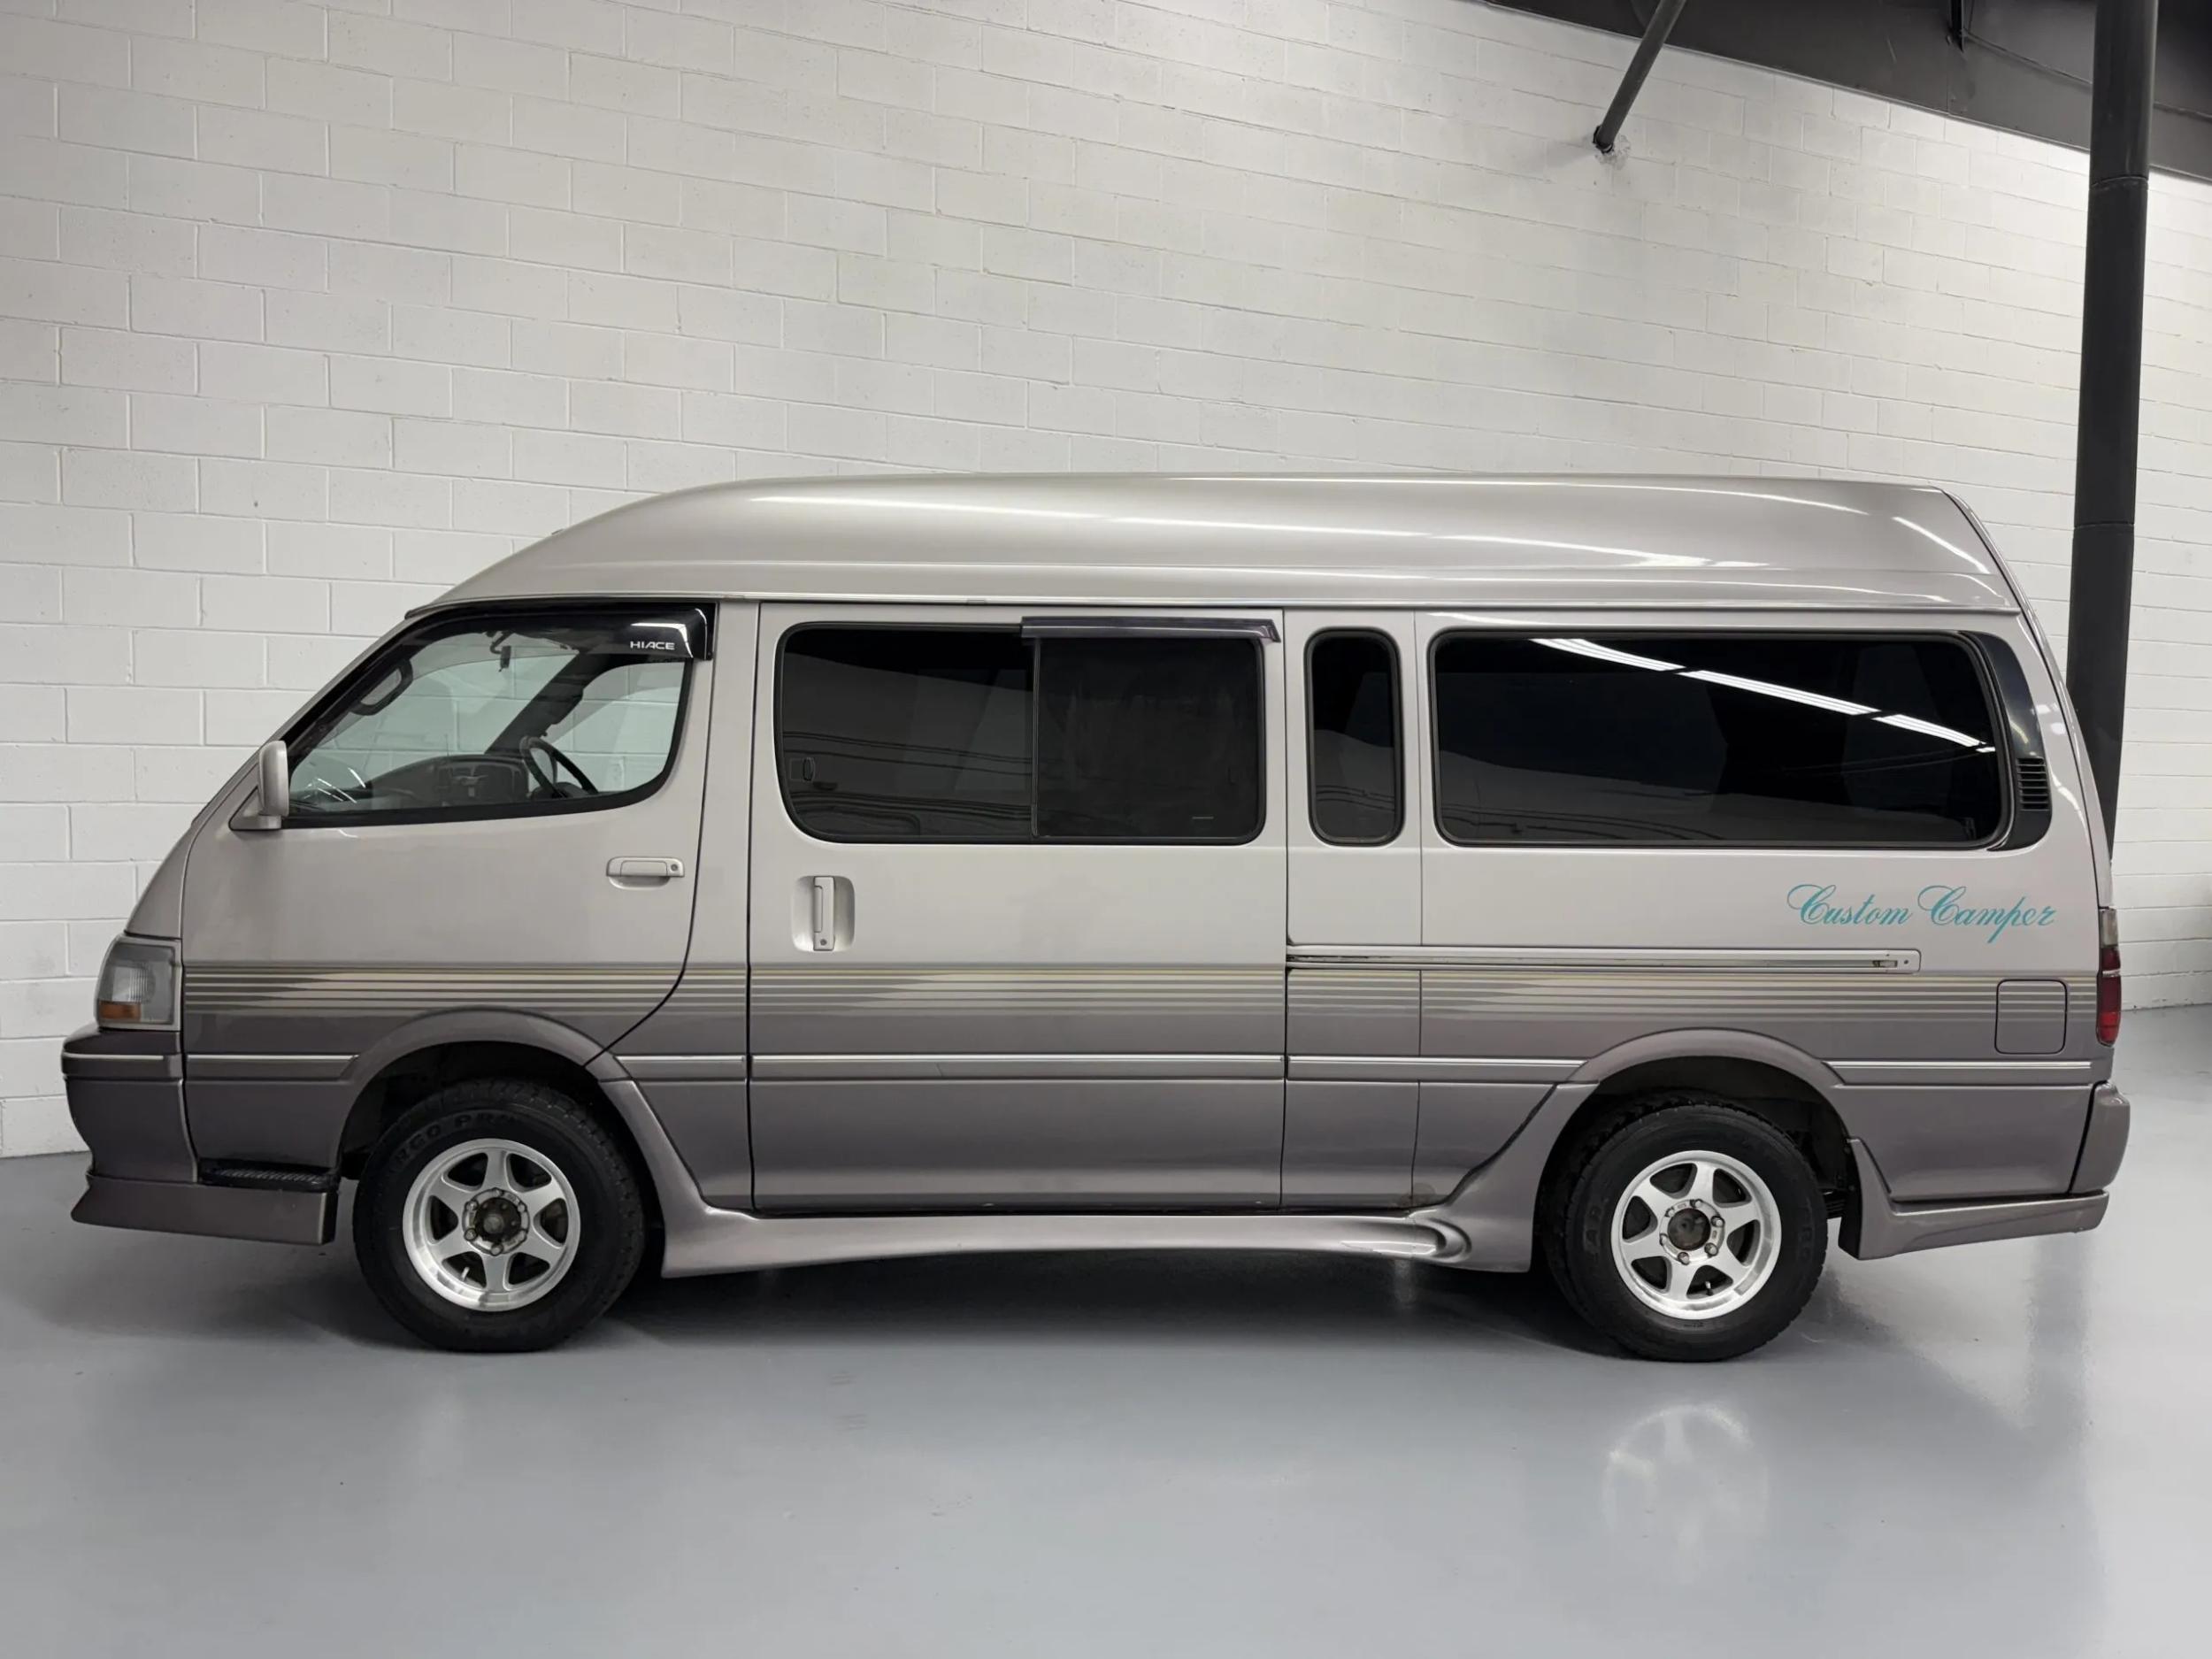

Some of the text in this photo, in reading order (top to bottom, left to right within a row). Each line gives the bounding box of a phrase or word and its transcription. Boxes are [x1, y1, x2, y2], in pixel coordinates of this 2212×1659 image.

[630, 641, 675, 650] HIACE
[1786, 884, 2056, 944] Custom Camper
